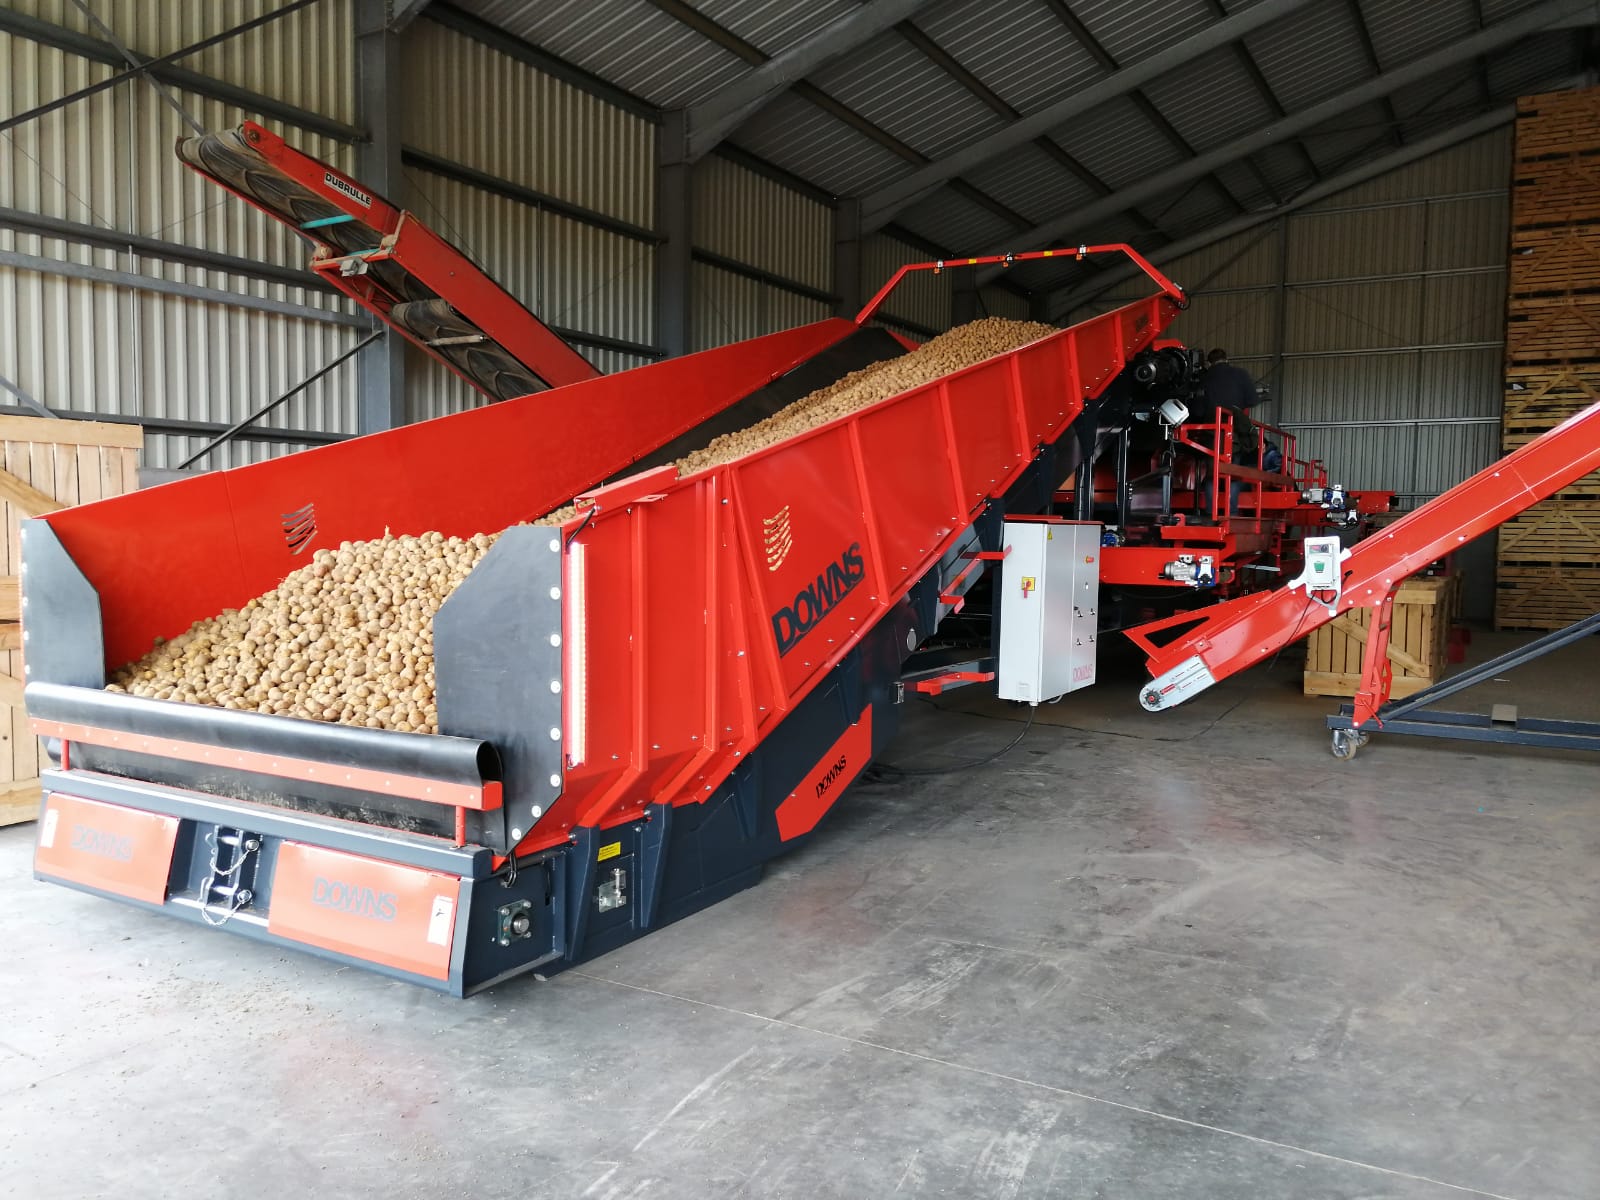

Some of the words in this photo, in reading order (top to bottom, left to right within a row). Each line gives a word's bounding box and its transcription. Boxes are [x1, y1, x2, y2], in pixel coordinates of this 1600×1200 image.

[325, 172, 371, 206] DUBRULLE
[771, 542, 865, 658] DOWNS
[815, 755, 847, 799] DOWNS
[313, 876, 397, 922] DOWNS
